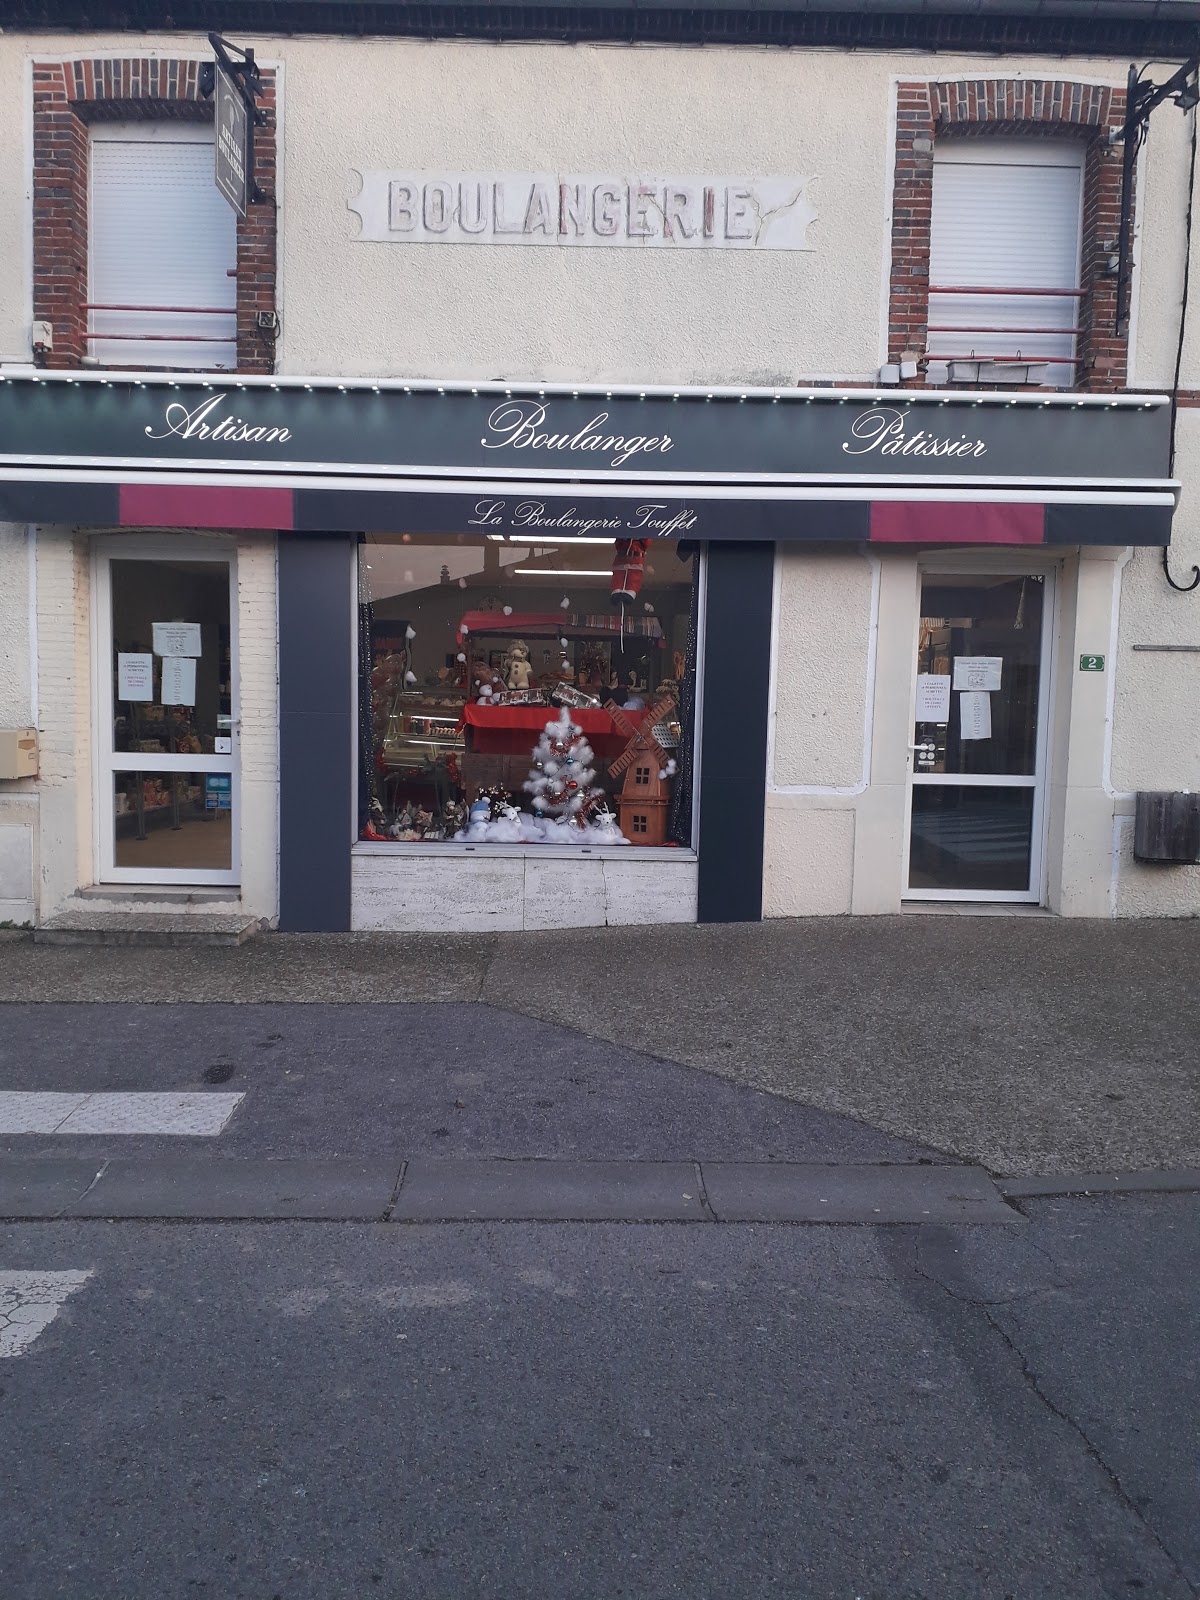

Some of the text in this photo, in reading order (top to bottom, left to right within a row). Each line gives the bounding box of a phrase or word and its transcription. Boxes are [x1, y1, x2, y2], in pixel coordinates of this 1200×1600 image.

[218, 134, 245, 184] BOULANGER
[222, 123, 242, 163] ARTISAN
[387, 179, 753, 240] BOULANGERIE
[144, 393, 988, 467] Artisan Boulanger Pâtissier
[467, 499, 698, 537] La Boulangerie Touffet
[1087, 656, 1097, 669] 2
